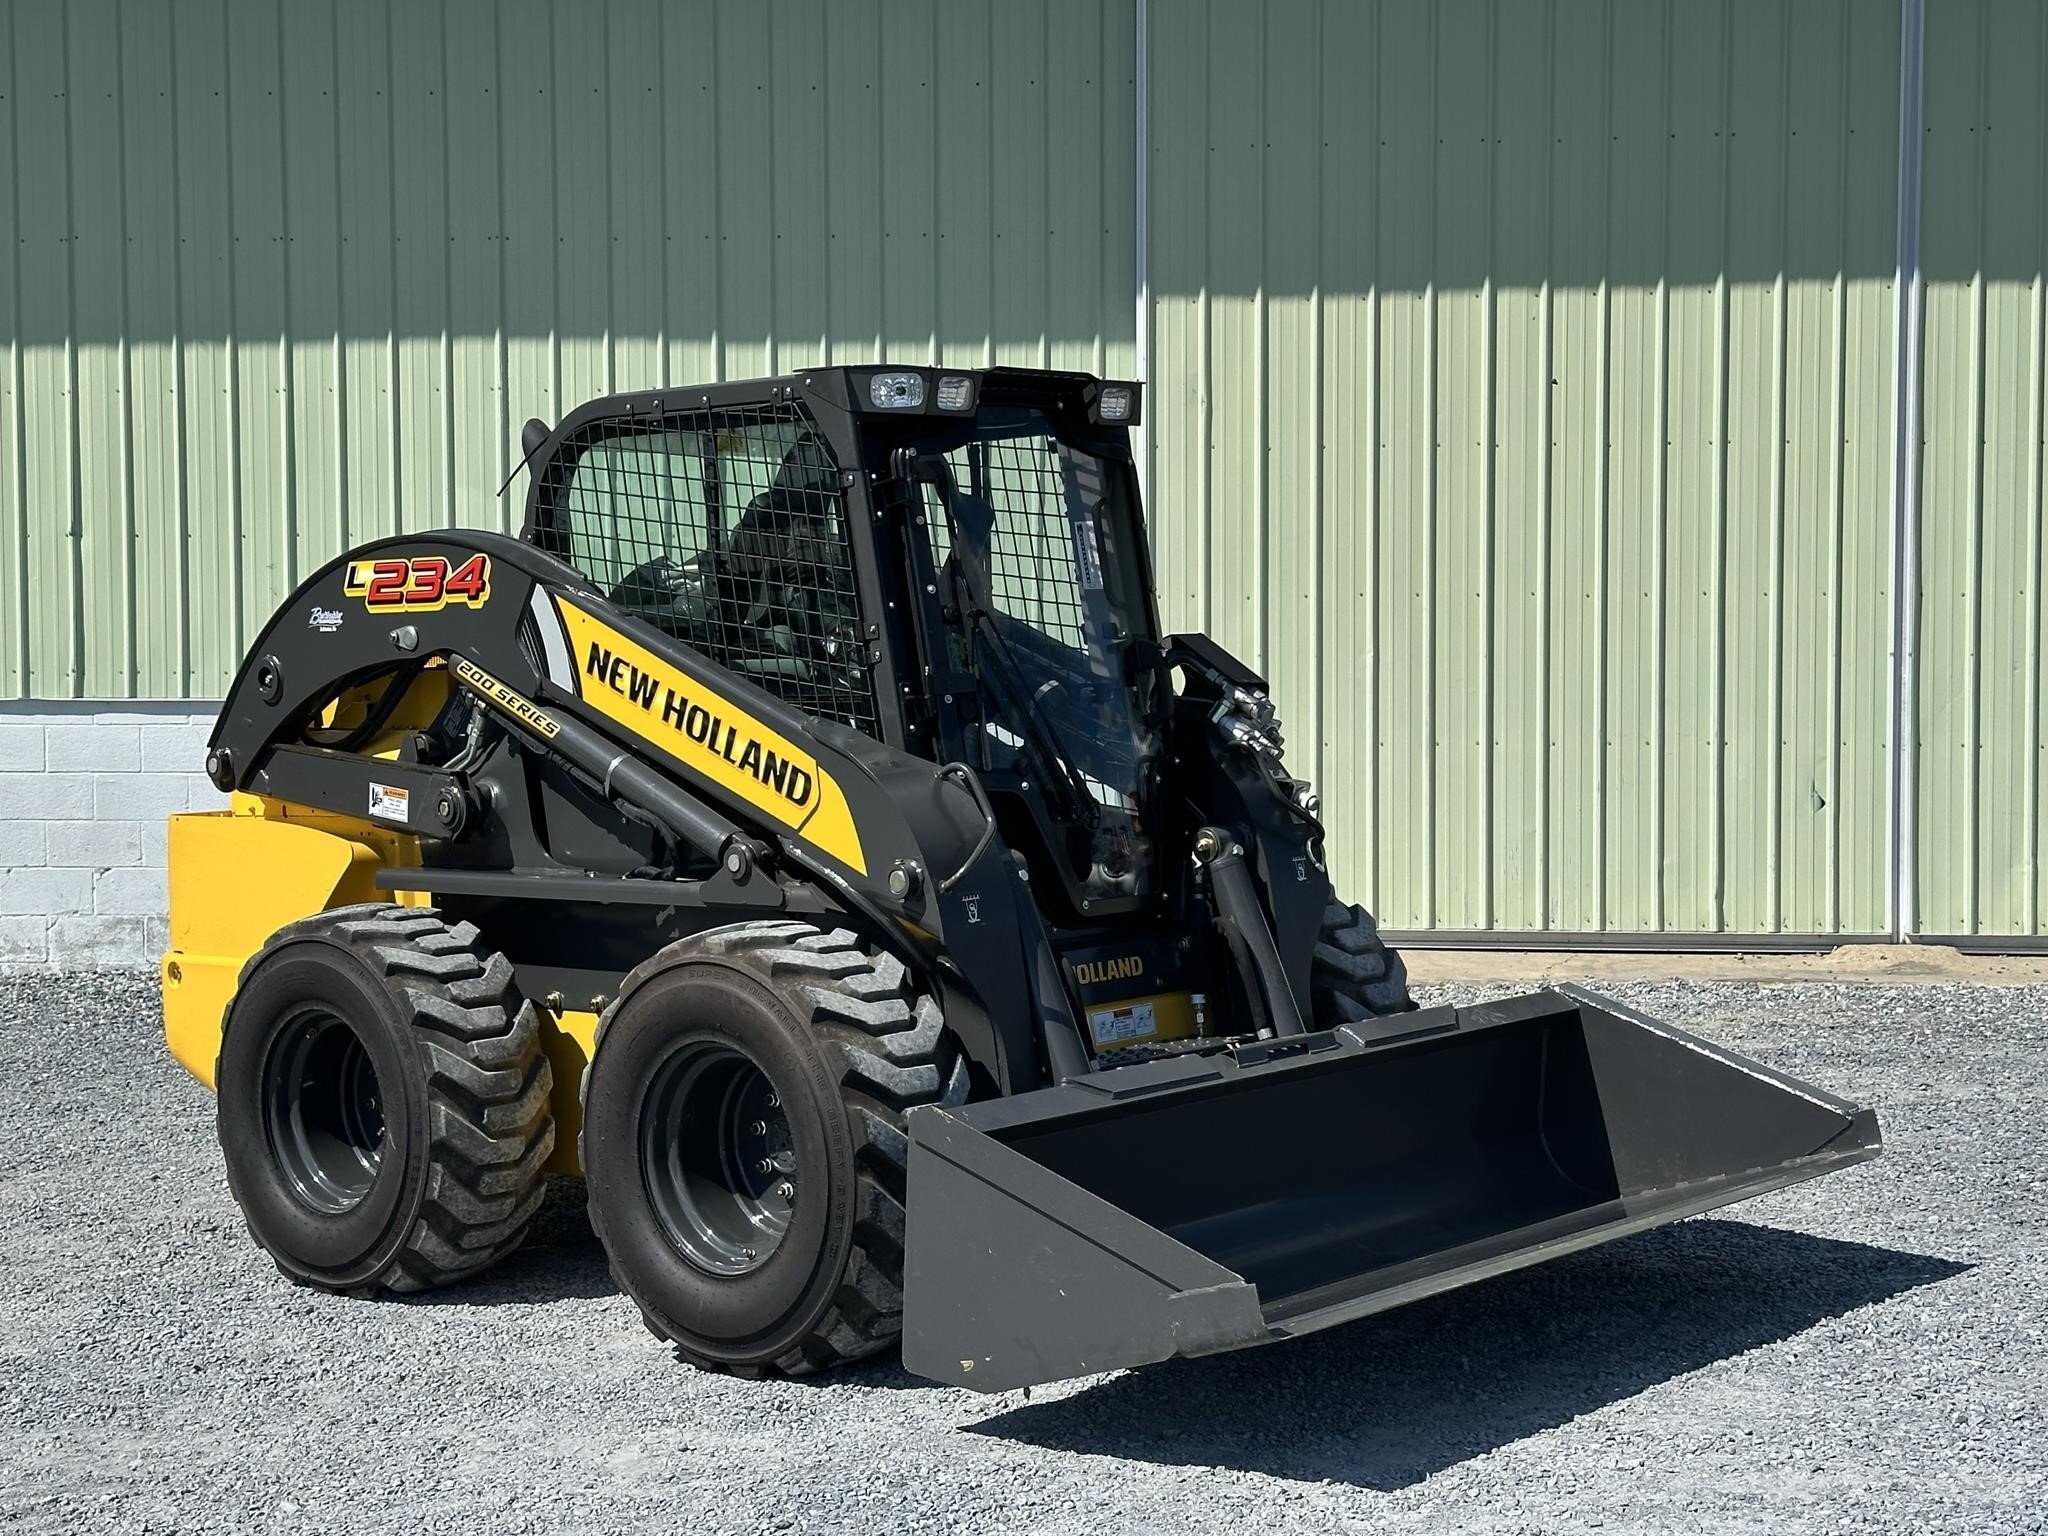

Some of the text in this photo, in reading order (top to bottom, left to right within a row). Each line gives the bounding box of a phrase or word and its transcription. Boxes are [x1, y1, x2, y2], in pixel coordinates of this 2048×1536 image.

[346, 555, 488, 607] L234
[459, 662, 559, 735] 200 SERIES
[586, 641, 812, 807] NEW HOLLAND
[1072, 956, 1144, 985] OLLAND
